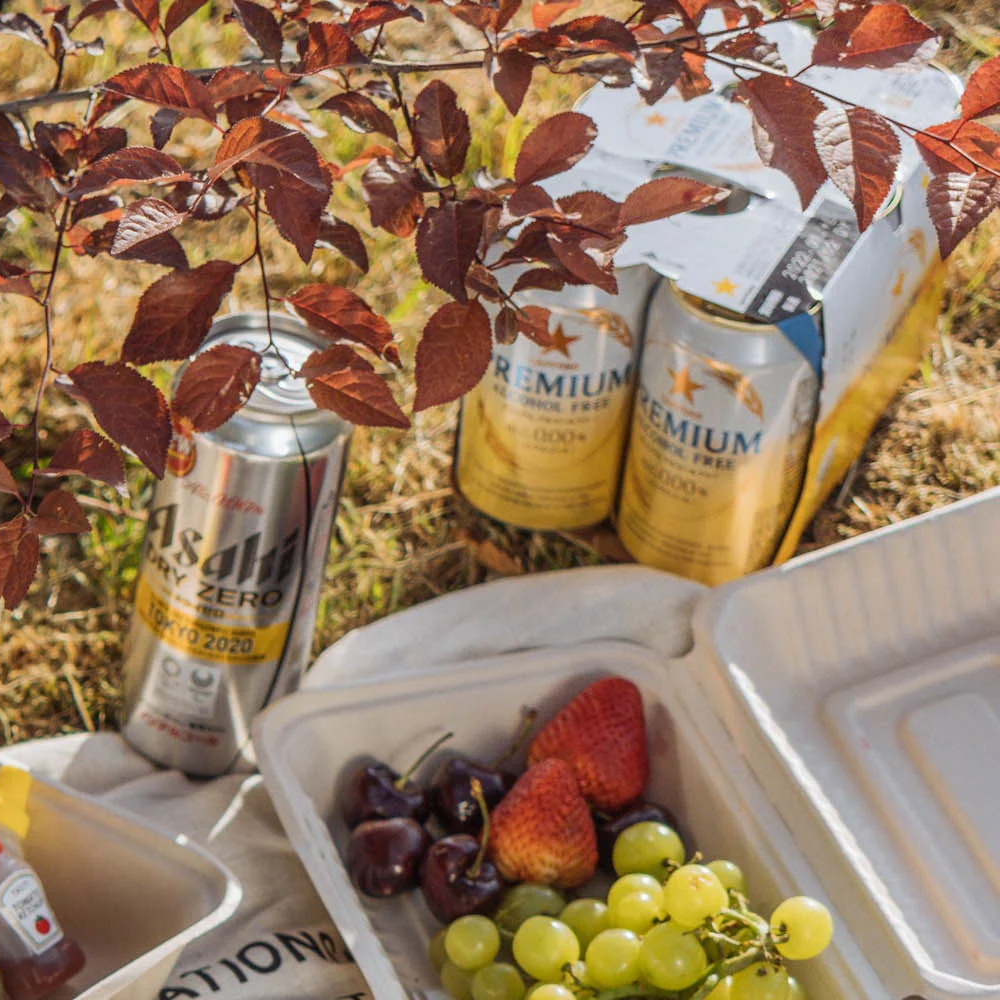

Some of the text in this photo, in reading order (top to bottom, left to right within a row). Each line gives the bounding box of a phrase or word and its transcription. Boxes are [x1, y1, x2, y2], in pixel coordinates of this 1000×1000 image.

[490, 353, 633, 398] REMIUM
[638, 383, 763, 455] REMIUM
[149, 503, 300, 586] Asahi
[197, 581, 283, 609] ZERO
[203, 633, 255, 655] 2020
